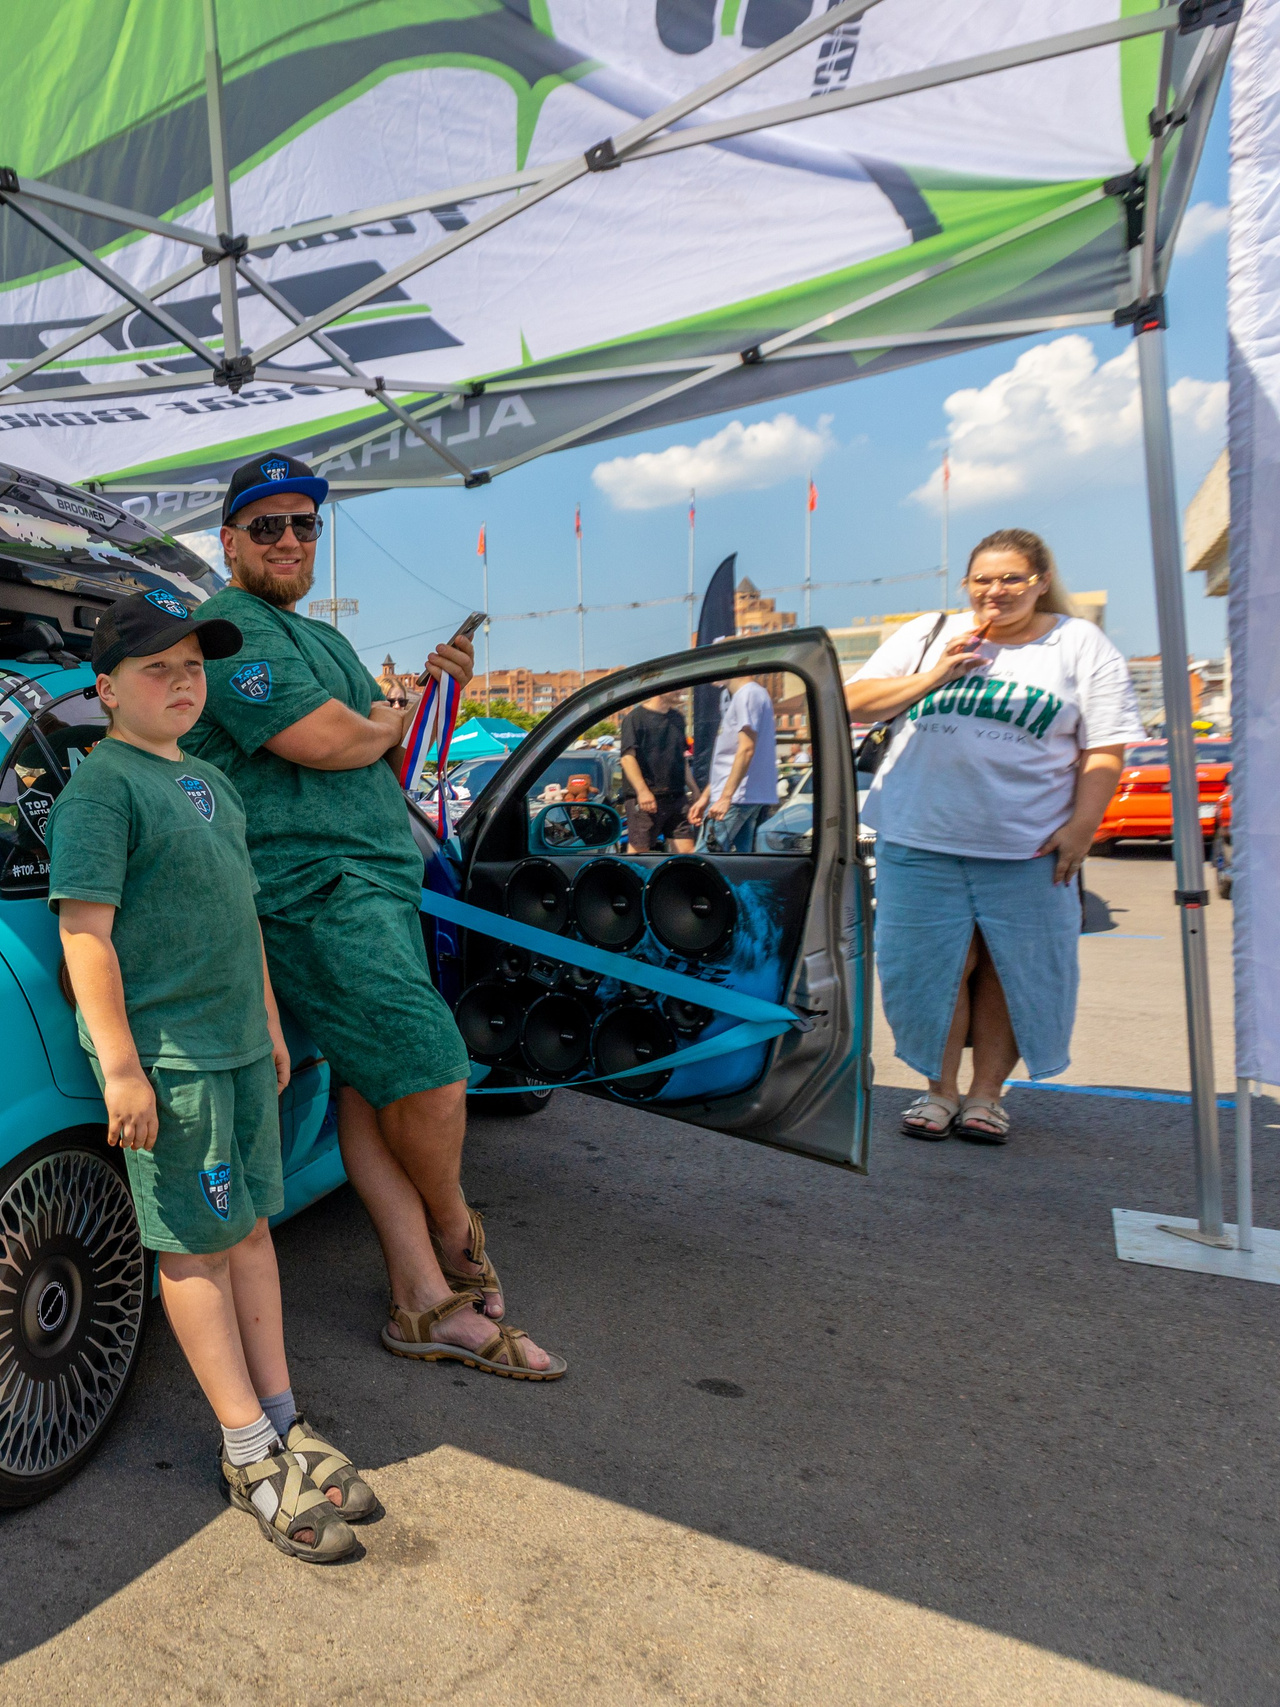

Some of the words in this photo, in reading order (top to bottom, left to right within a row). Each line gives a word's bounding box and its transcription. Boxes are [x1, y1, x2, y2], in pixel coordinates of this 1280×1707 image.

[57, 498, 106, 524] BROOMER
[920, 721, 959, 735] NEW
[25, 800, 49, 810] TOP
[12, 863, 51, 877] #TOP_BA
